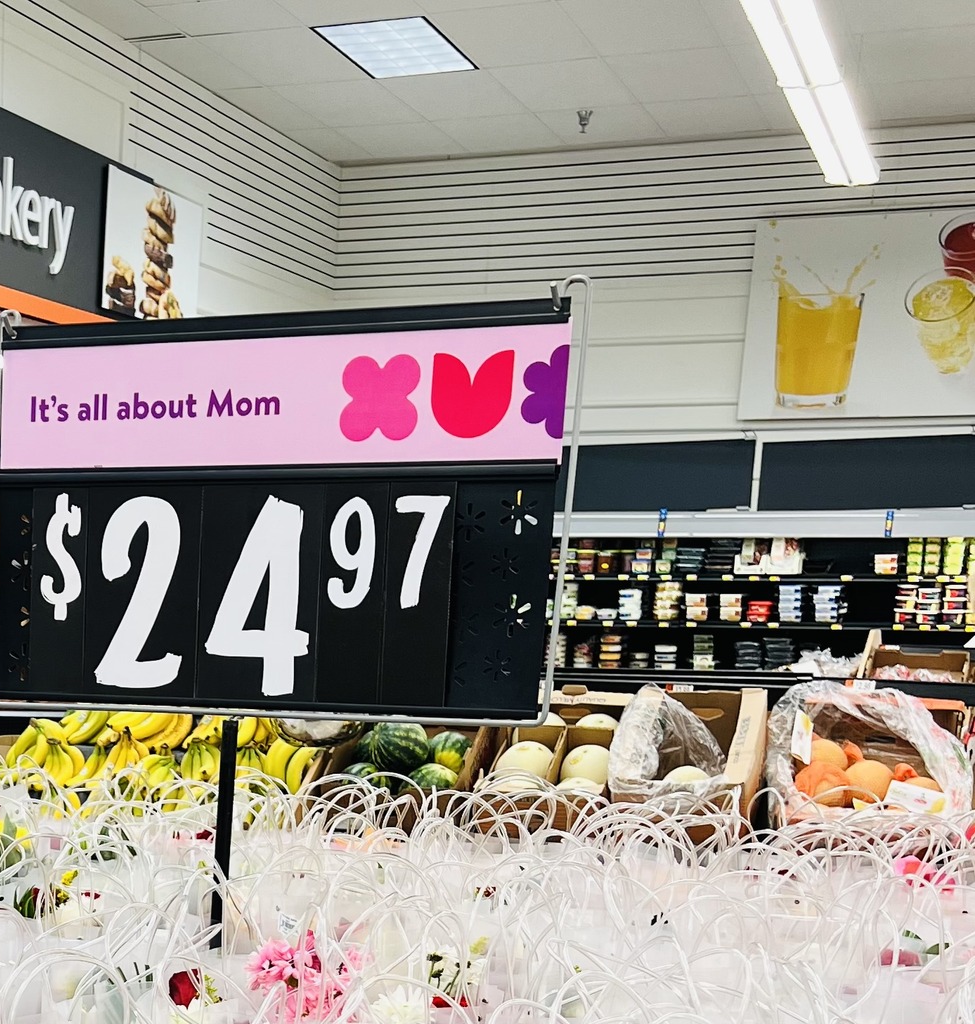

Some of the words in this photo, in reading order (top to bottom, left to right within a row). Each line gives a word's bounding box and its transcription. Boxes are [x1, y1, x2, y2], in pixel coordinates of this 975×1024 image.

[30, 395, 69, 422] It's
[77, 393, 108, 421] all
[117, 392, 197, 420] about
[206, 388, 281, 418] Mom
